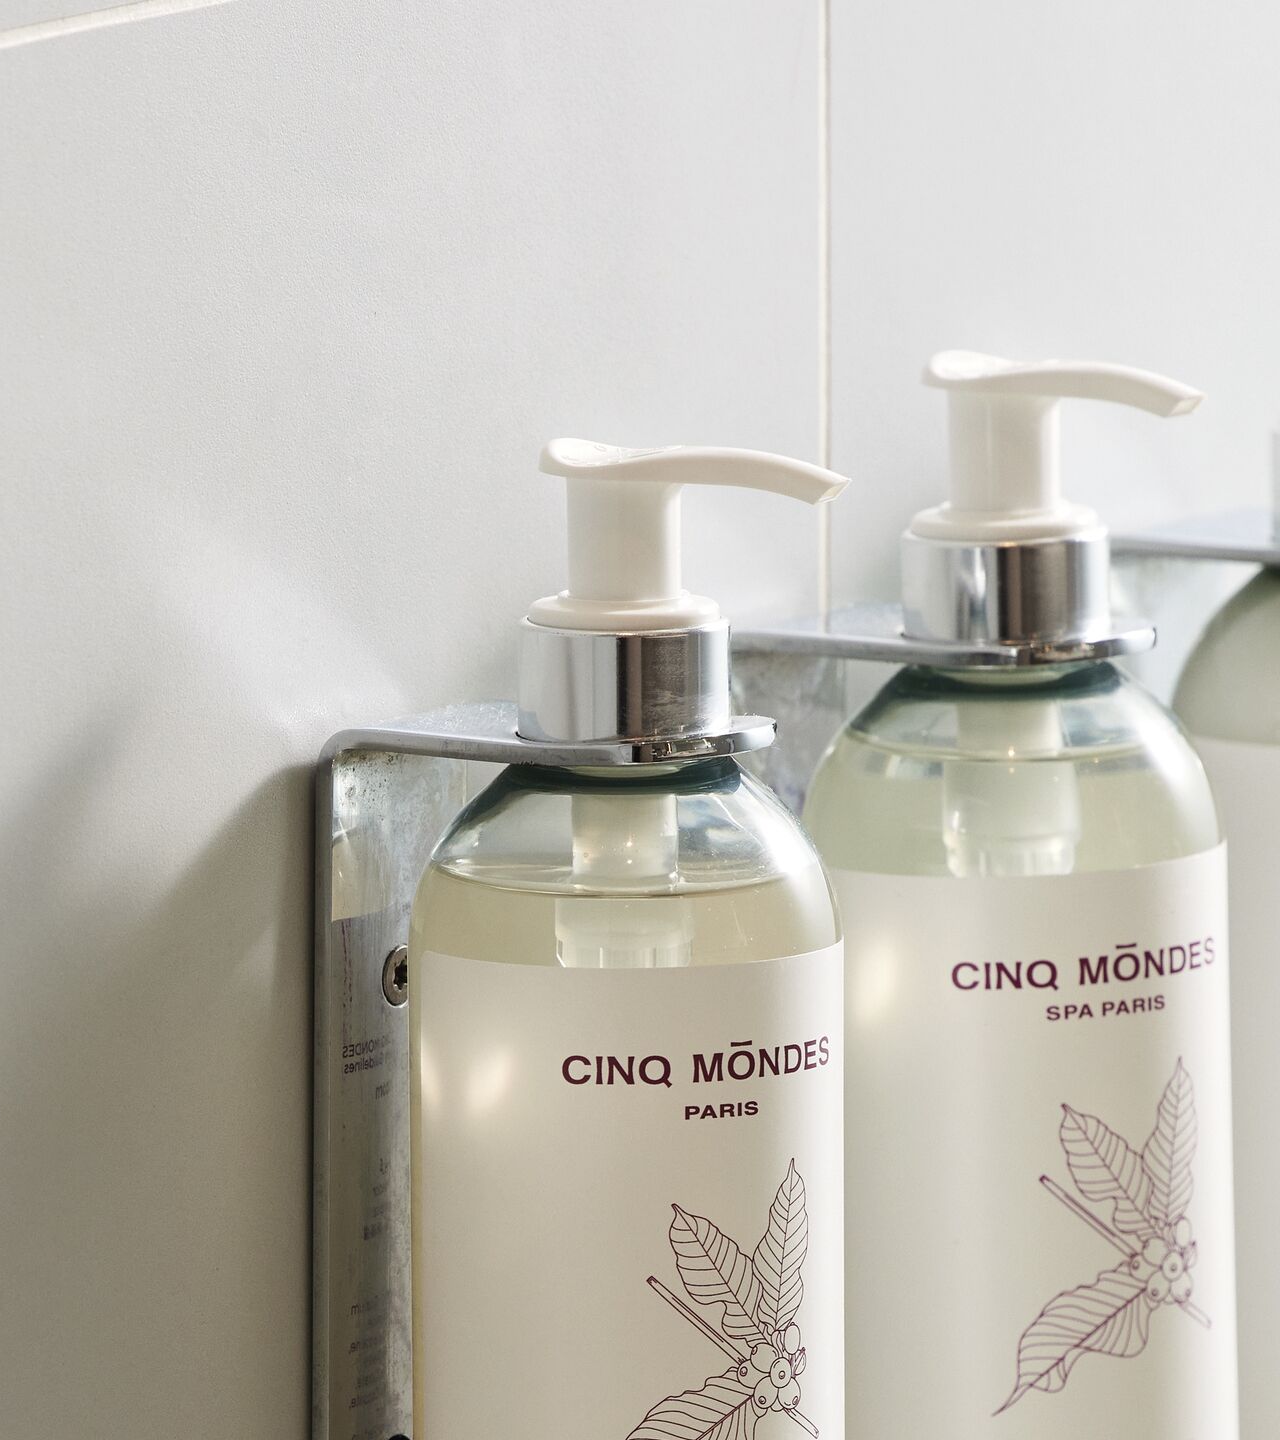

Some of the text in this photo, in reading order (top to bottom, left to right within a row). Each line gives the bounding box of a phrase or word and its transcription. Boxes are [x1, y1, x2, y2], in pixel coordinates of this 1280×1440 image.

[951, 960, 1060, 991] CINQ
[1046, 994, 1166, 1021] SPA PARIS
[561, 1054, 672, 1088] CINQ
[684, 1100, 759, 1120] PARIS
